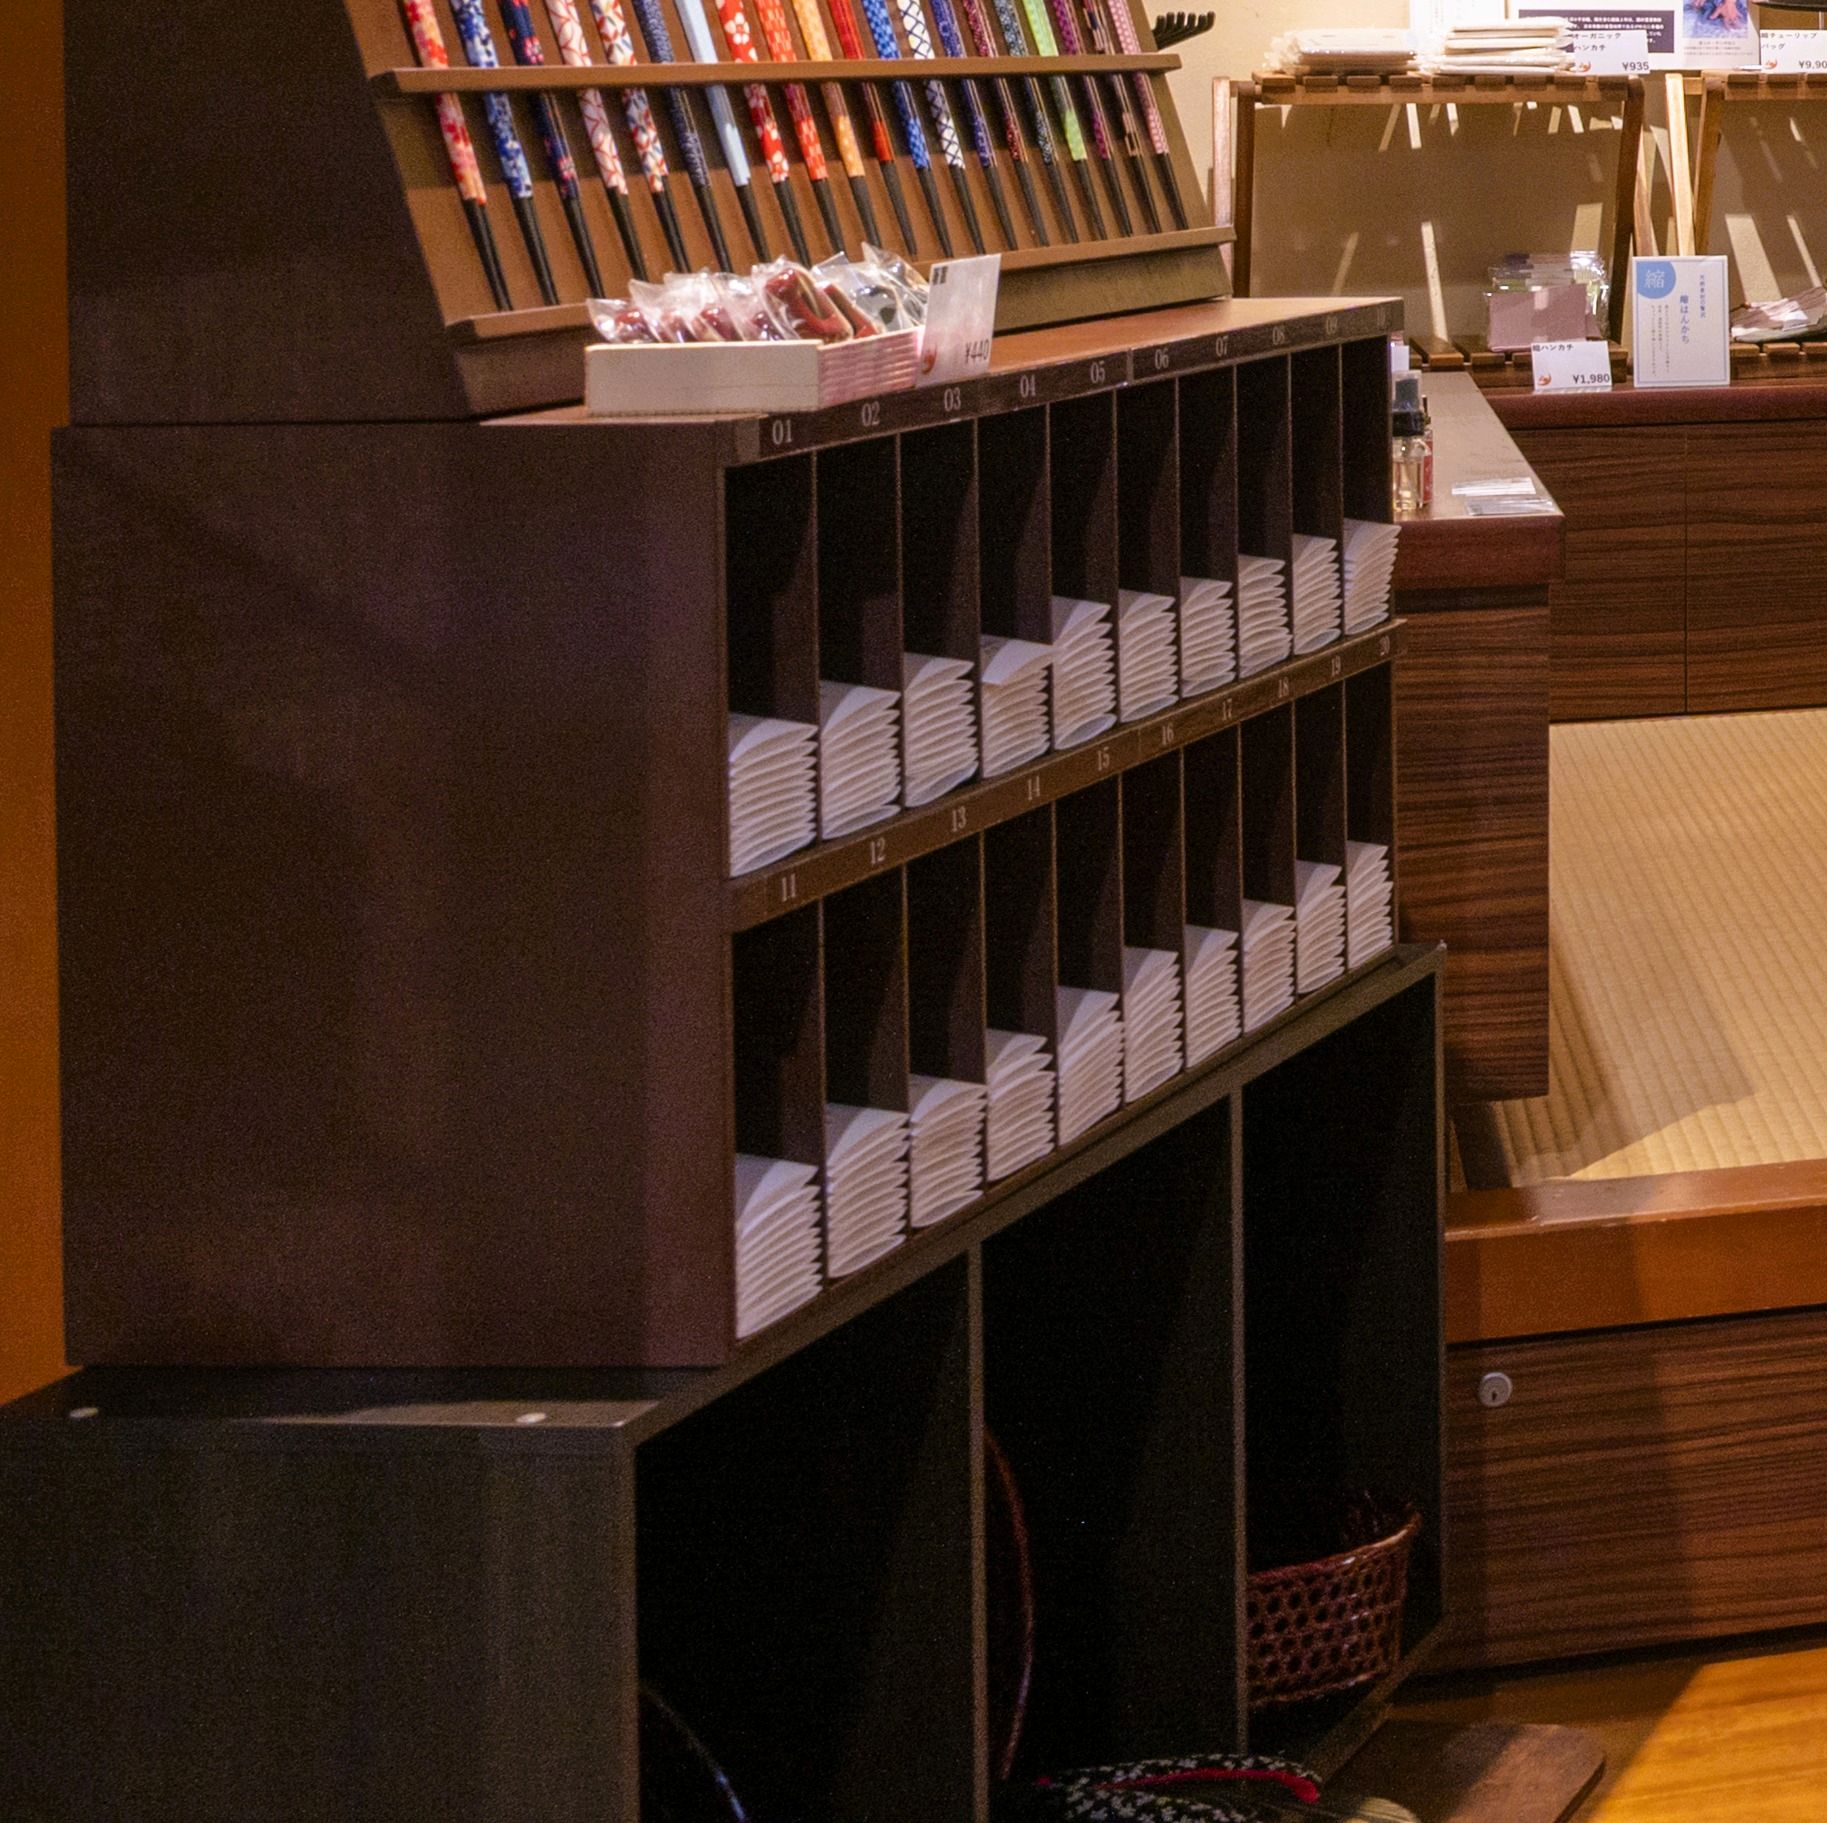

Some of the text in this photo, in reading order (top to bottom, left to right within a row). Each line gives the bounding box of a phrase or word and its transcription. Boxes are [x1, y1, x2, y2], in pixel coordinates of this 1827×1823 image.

[1574, 43, 1606, 51] ハンカチ
[1622, 61, 1650, 70] ¥935
[1645, 270, 1665, 288] 縮
[965, 339, 989, 364] ¥440
[1532, 344, 1574, 352] 縮ハンカチ
[772, 420, 792, 444] 01
[861, 402, 880, 426] 02
[944, 388, 961, 411] 03
[1019, 375, 1036, 398] 04
[1090, 360, 1106, 383] 05
[1154, 349, 1169, 369] 06
[1215, 336, 1229, 357] 07
[1272, 326, 1285, 345] 08
[1325, 316, 1339, 334] 09
[1572, 373, 1610, 384] ¥1,980
[781, 873, 797, 902] 11
[870, 837, 886, 864] 12
[951, 806, 967, 832] 13
[1027, 776, 1041, 801] 14
[1097, 746, 1110, 771] 15
[1161, 723, 1175, 746] 16
[1222, 698, 1233, 720] 17
[1278, 676, 1290, 698] 18
[1331, 656, 1342, 676] 19
